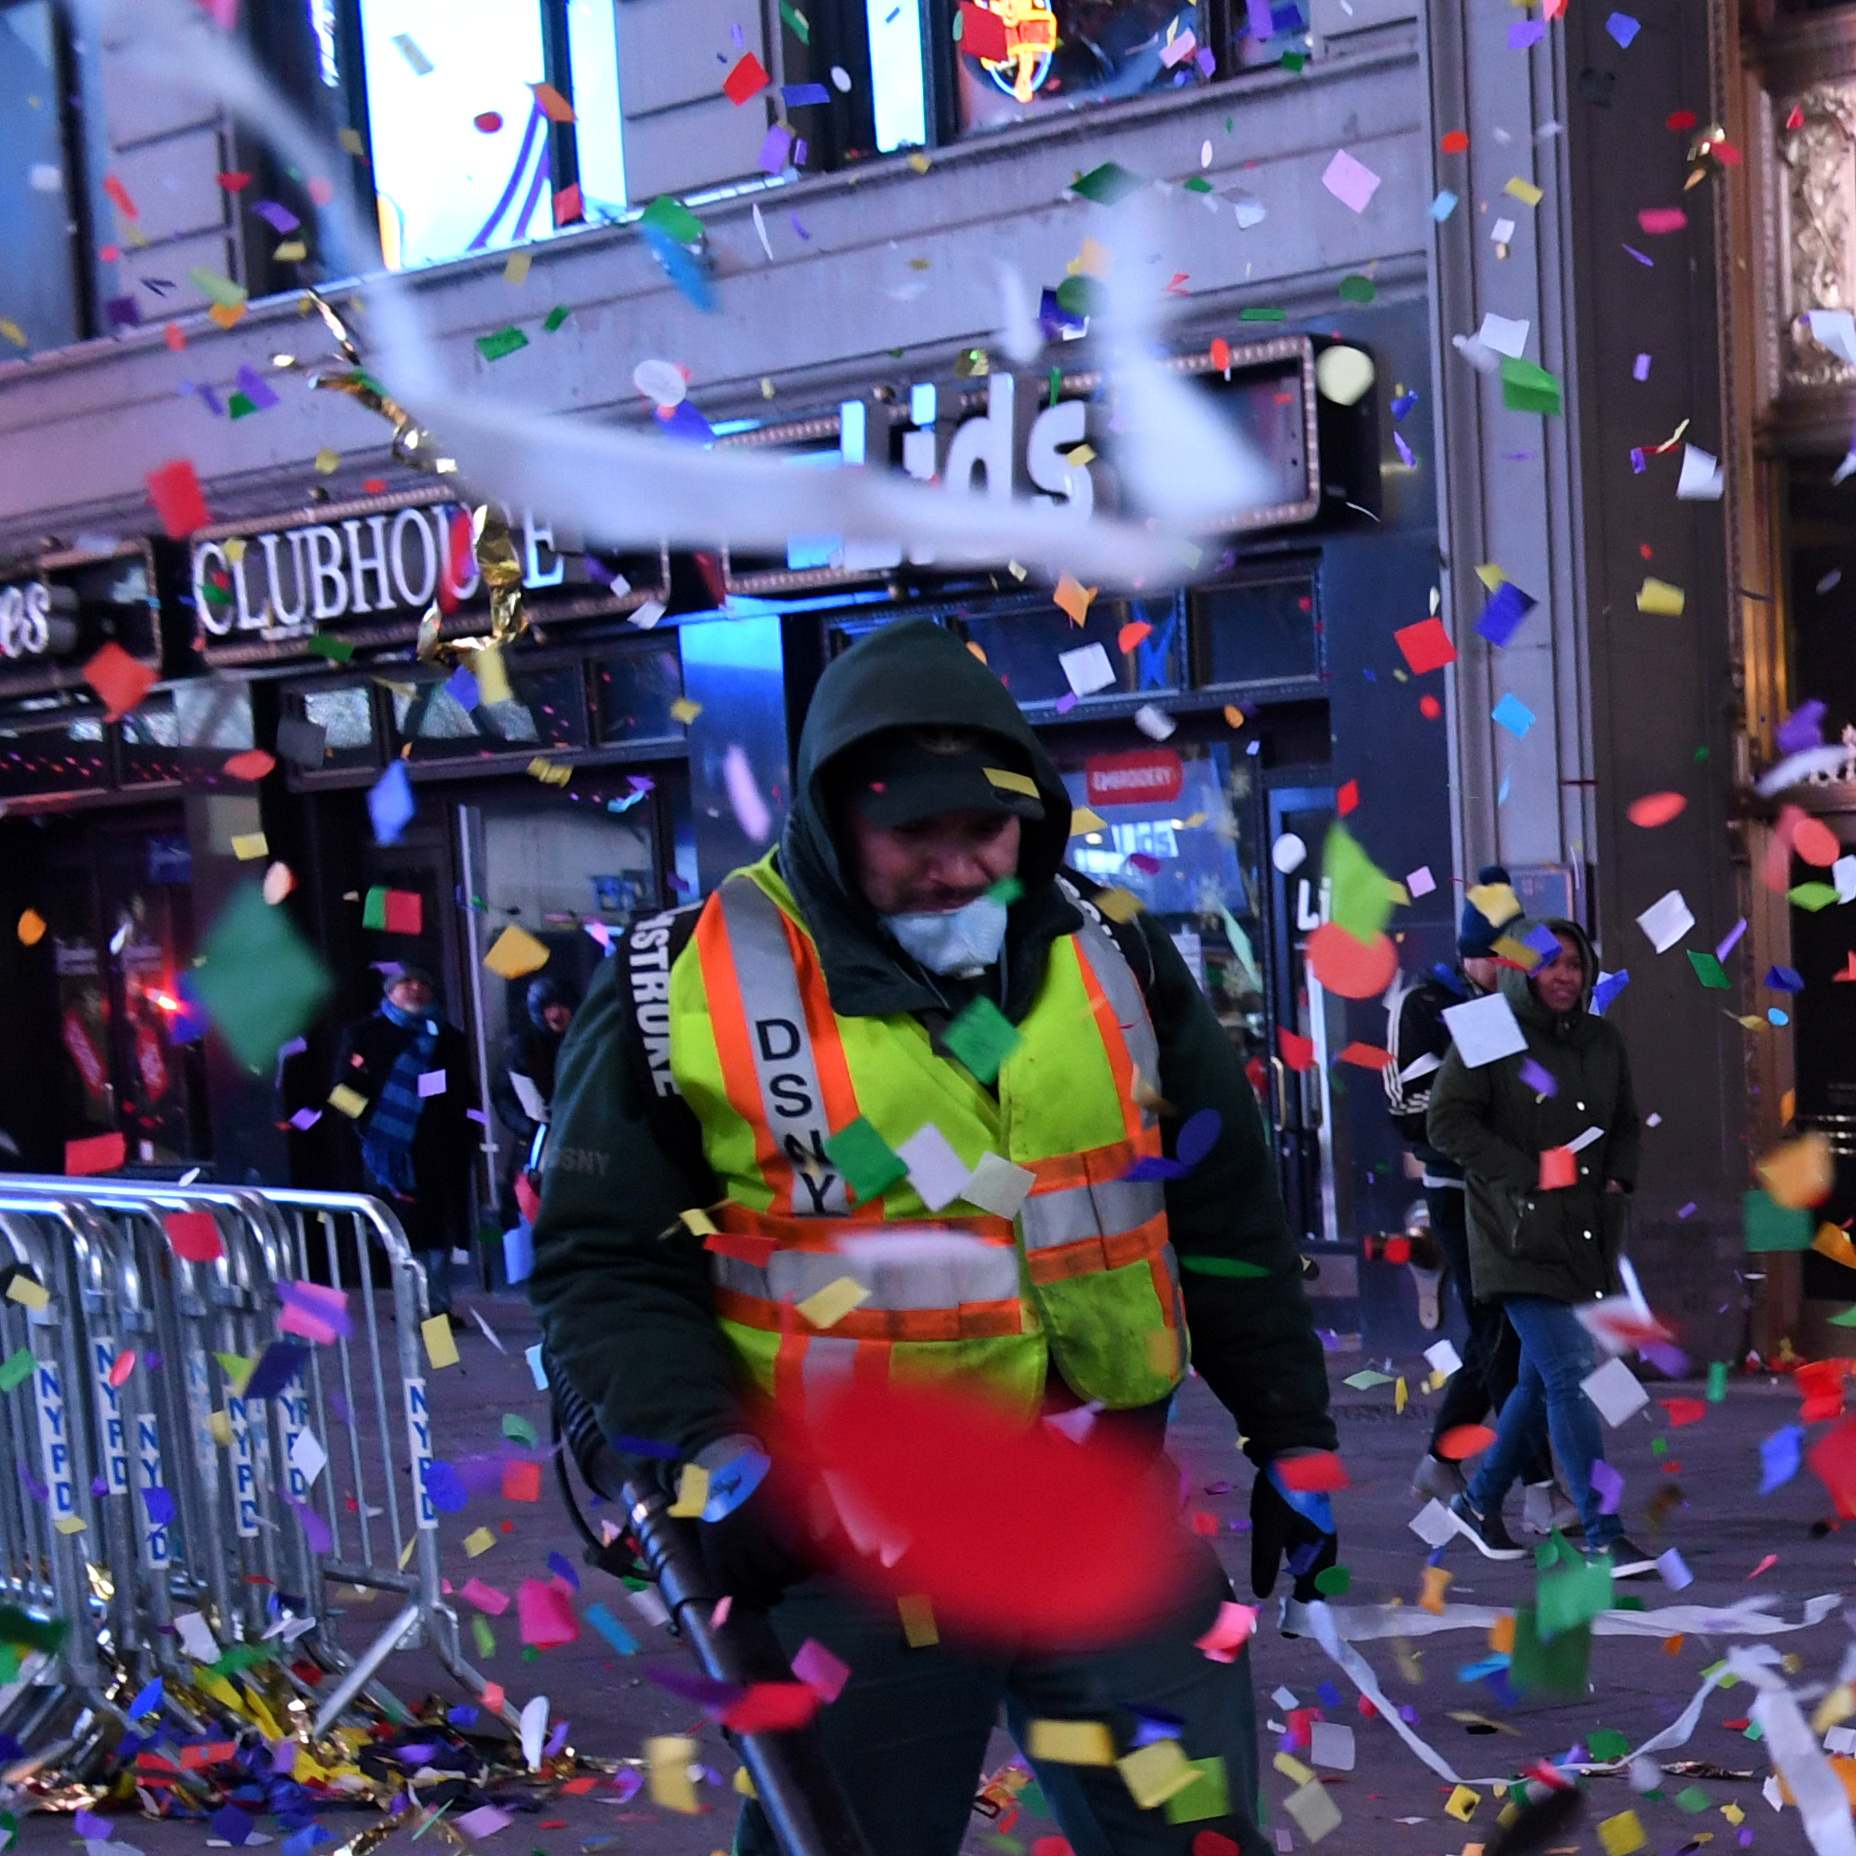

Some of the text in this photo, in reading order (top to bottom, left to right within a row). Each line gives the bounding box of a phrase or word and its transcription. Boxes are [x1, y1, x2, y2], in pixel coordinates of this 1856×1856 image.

[193, 503, 564, 636] CLUBHOUE
[755, 1018, 836, 1214] DSNY
[39, 1368, 73, 1512] NYPD
[139, 1421, 169, 1561] NYD
[229, 1397, 258, 1529] NYPD
